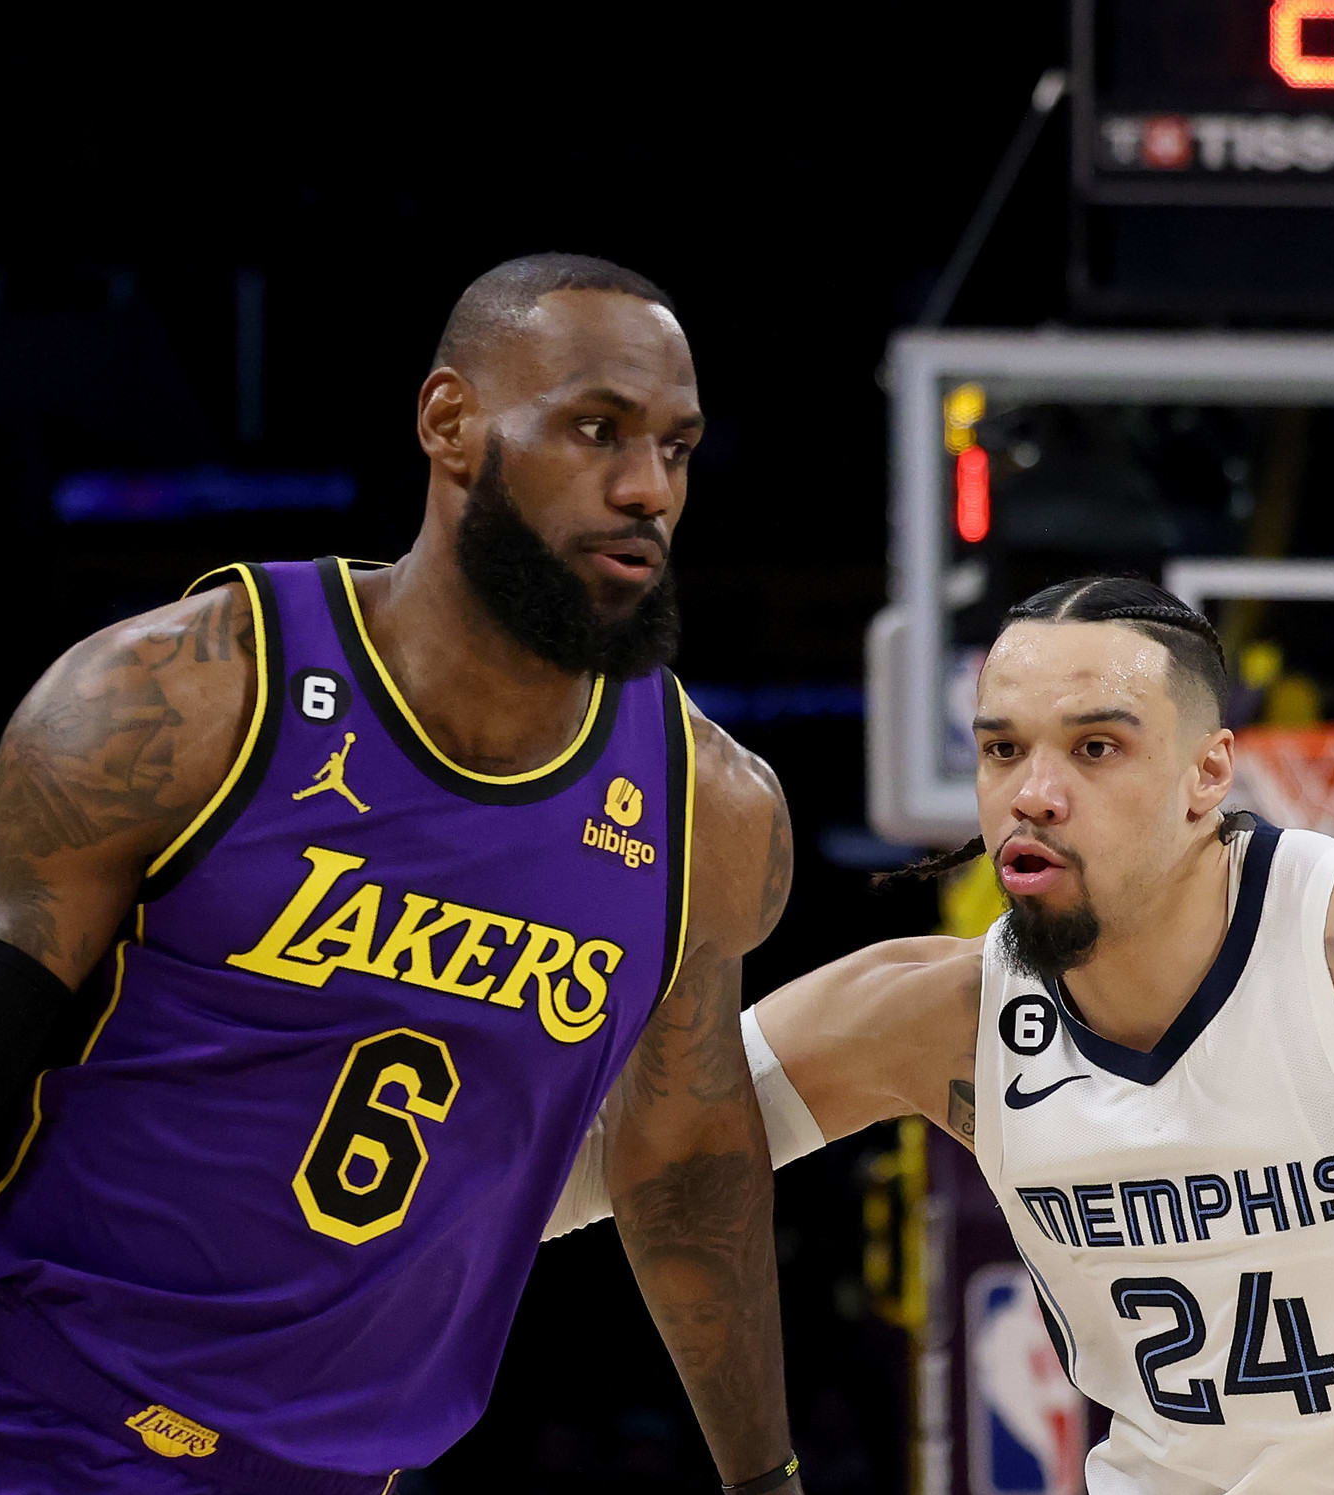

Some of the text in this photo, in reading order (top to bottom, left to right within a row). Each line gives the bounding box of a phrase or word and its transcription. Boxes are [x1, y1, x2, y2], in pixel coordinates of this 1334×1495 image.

[302, 675, 337, 720] 6
[582, 818, 656, 869] bibigo
[224, 845, 624, 1044] LAKERS
[1014, 1004, 1045, 1048] 6
[292, 1027, 461, 1246] 6
